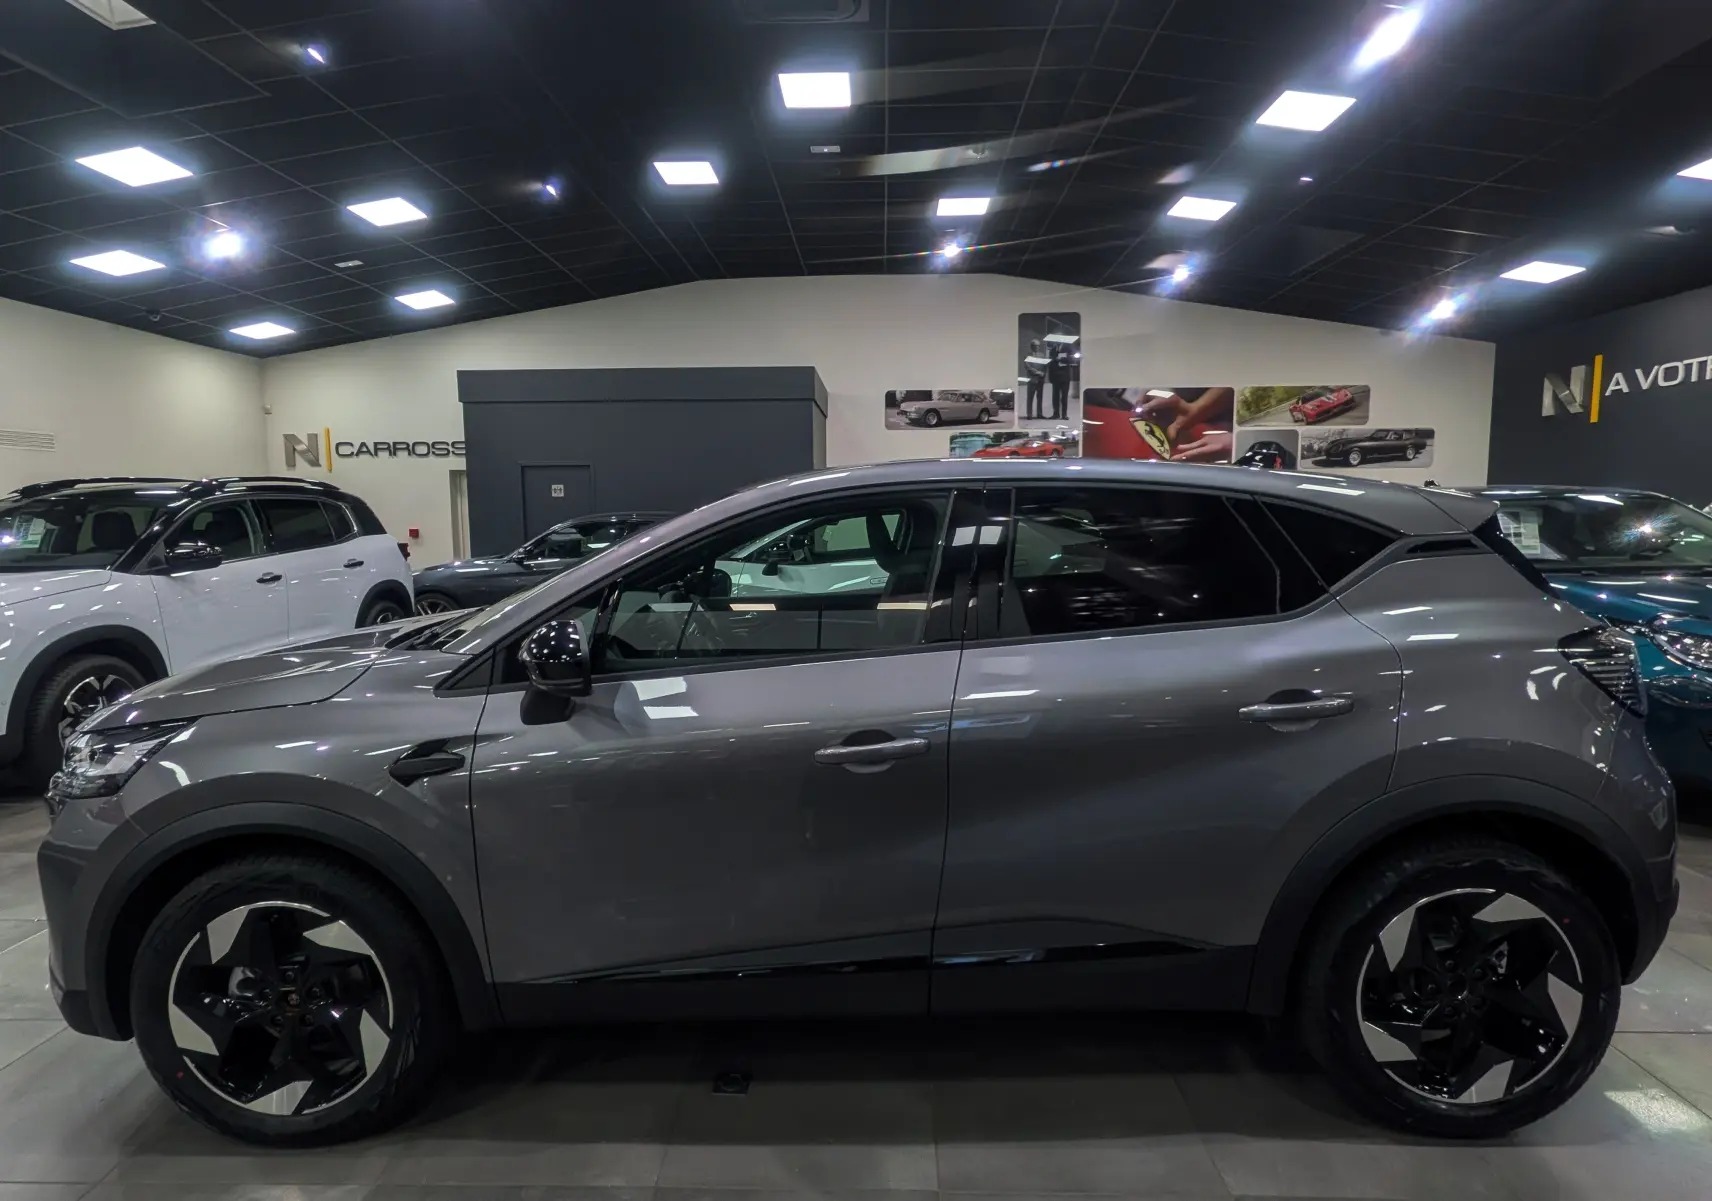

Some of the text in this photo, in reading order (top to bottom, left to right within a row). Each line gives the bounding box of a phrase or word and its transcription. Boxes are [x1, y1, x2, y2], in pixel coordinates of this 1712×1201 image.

[1542, 365, 1586, 417] N
[1605, 372, 1629, 396] A
[283, 433, 322, 467] N
